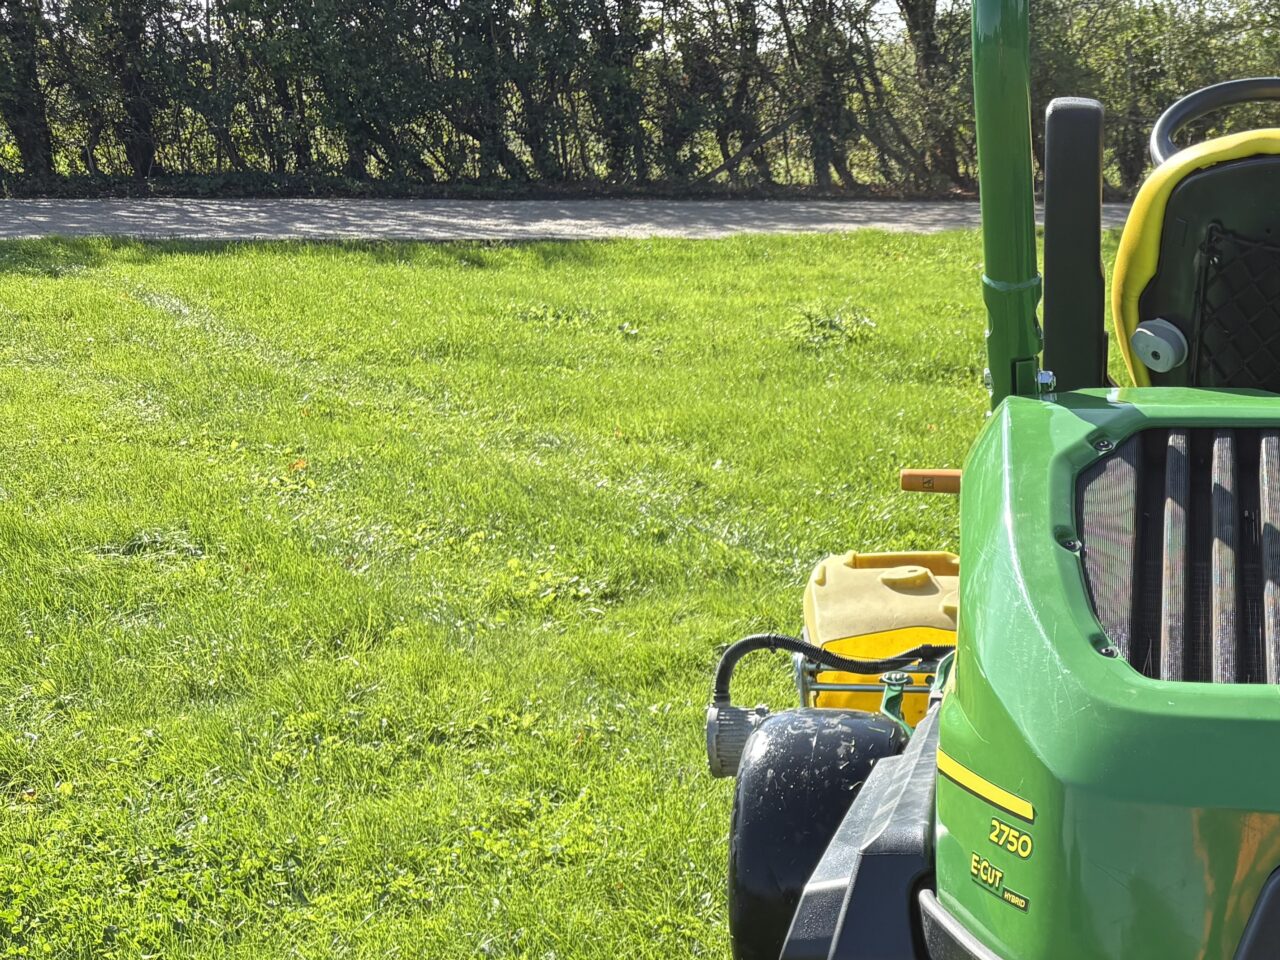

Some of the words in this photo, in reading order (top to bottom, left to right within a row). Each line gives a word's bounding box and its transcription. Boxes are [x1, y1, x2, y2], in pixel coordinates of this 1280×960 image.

[989, 819, 1032, 858] 2750
[971, 854, 1003, 888] E-CUT
[1004, 891, 1026, 908] HYBRID
